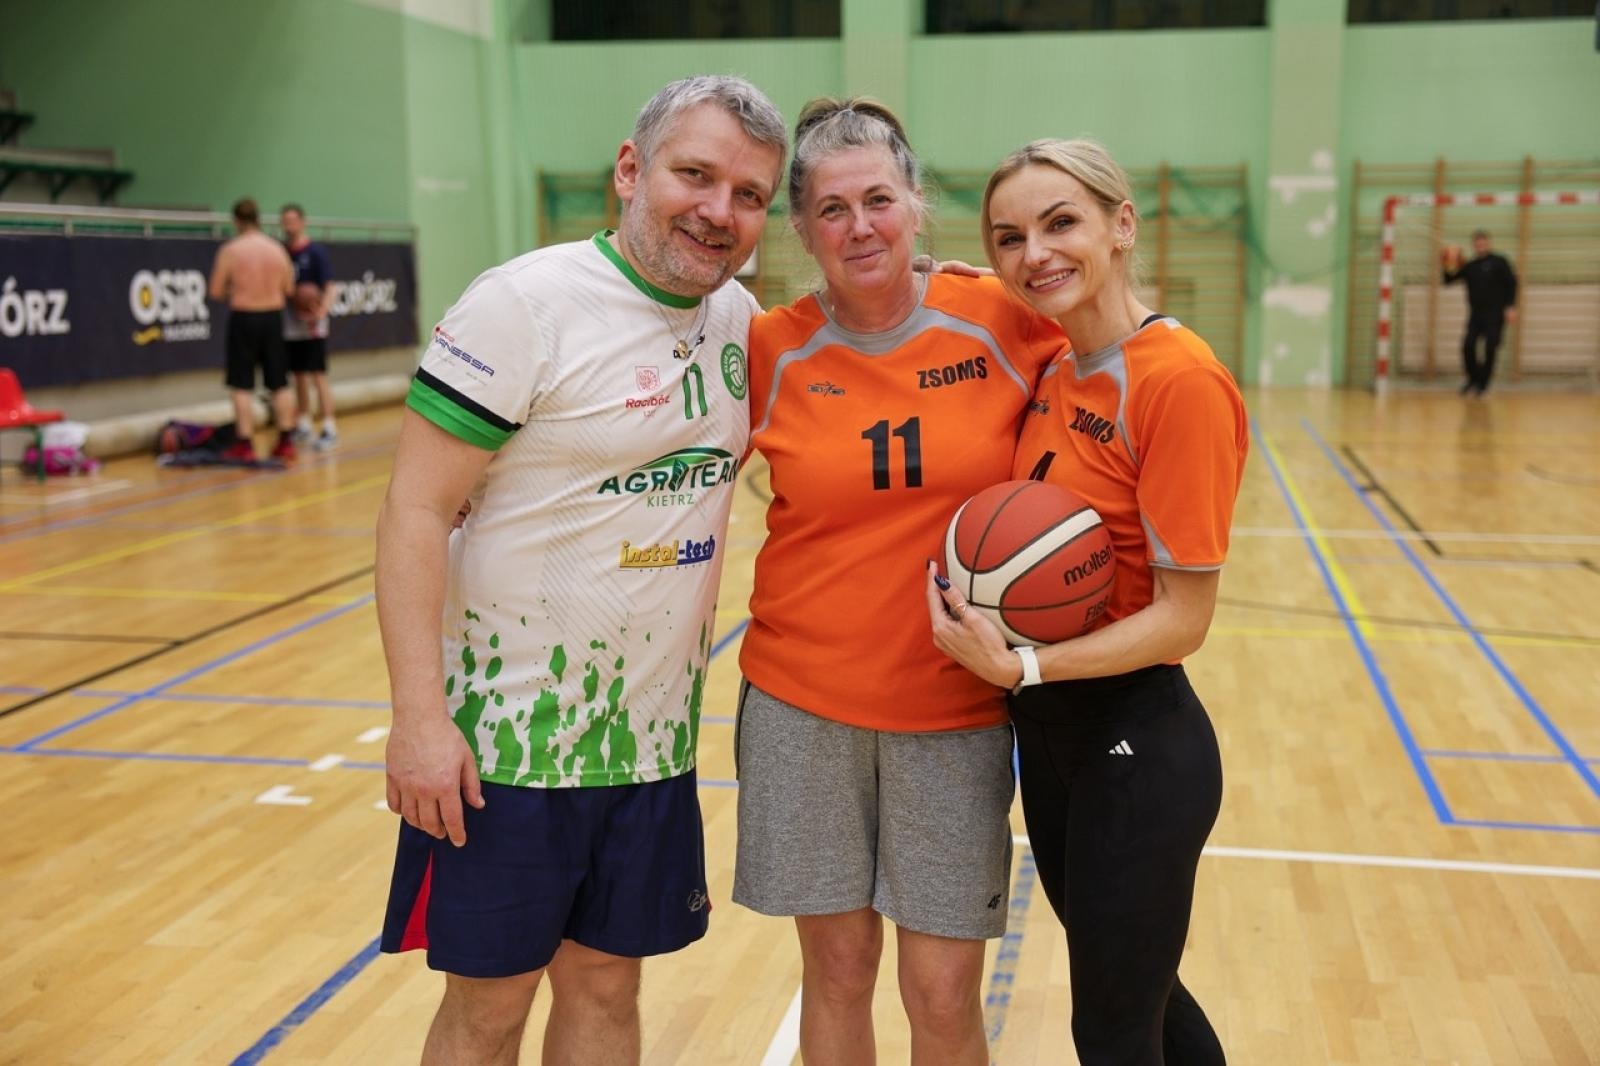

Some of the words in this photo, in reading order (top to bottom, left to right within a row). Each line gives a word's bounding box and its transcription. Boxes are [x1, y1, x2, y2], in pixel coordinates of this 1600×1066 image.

[0, 275, 70, 338] ÓRZ
[917, 356, 988, 389] ZSOMS
[1069, 406, 1115, 444] ZSOMS
[861, 416, 922, 490] 11
[647, 493, 695, 508] KIETRZ
[1064, 544, 1111, 586] molten
